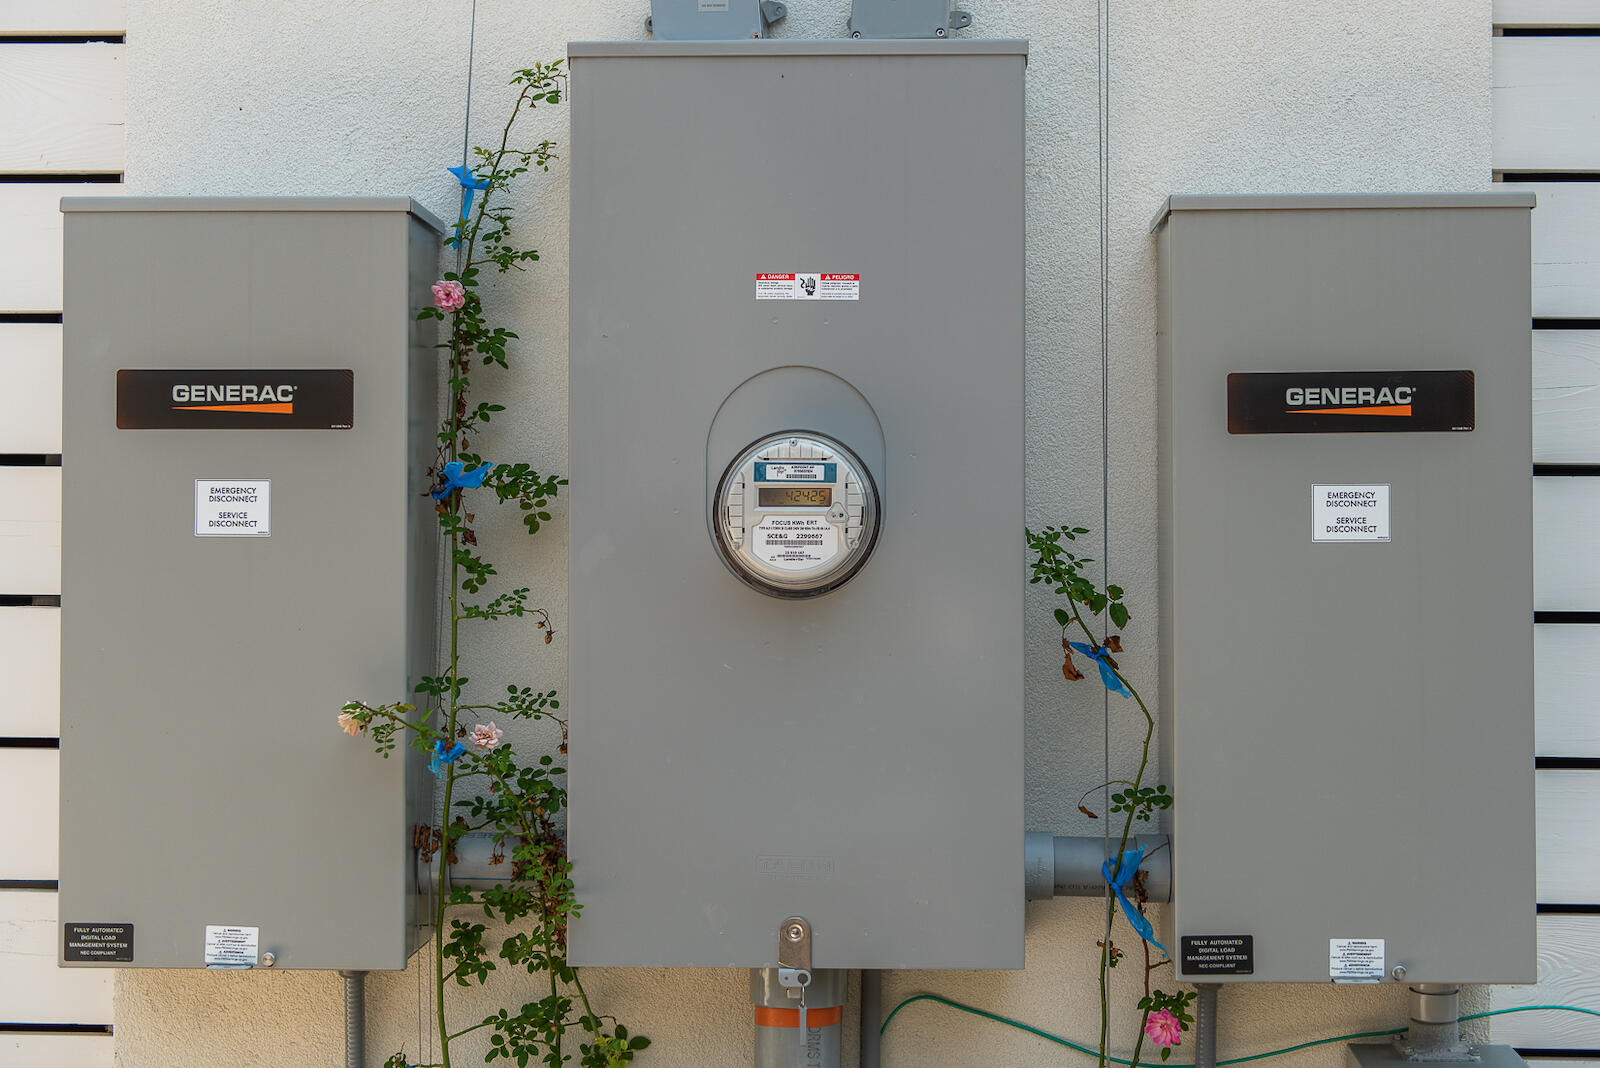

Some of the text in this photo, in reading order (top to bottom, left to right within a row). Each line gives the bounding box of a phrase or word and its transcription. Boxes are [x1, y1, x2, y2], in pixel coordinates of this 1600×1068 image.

[172, 385, 294, 402] GENERAC
[1286, 387, 1412, 405] GENERAC
[786, 490, 826, 502] 42425
